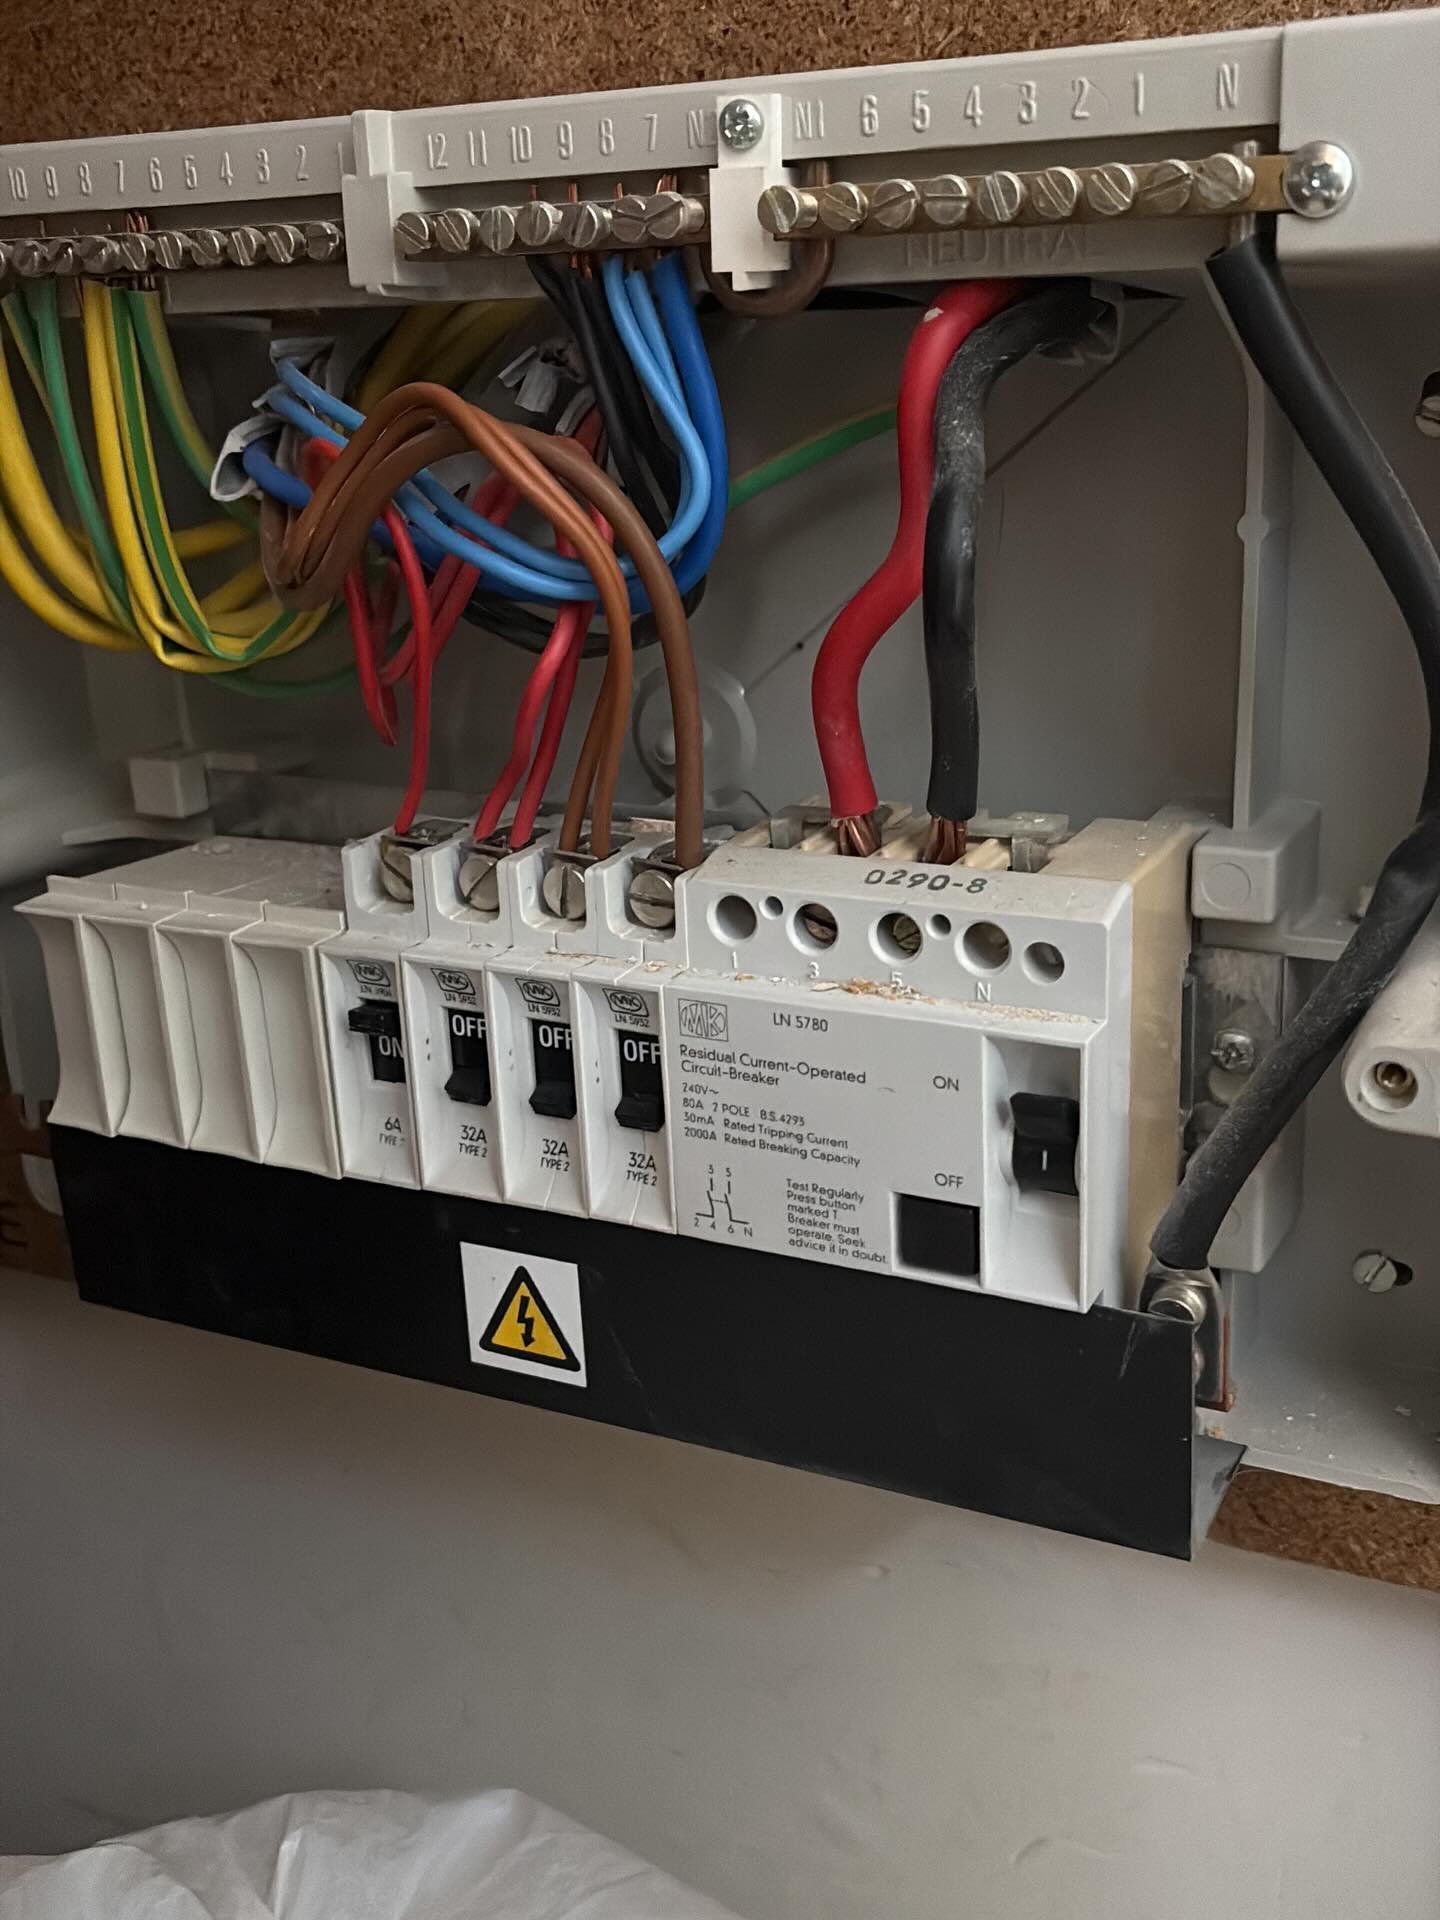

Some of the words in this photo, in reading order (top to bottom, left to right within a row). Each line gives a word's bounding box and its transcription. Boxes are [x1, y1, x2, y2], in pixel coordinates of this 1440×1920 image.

[860, 94, 878, 136] 6
[912, 89, 931, 132] 5
[964, 85, 983, 127] 4
[1018, 80, 1037, 124] 3
[1071, 76, 1090, 120] 2
[1134, 72, 1145, 116] 1
[1216, 63, 1240, 110] N
[427, 132, 448, 170] 12
[468, 128, 488, 166] 11
[509, 124, 533, 163] 10
[558, 120, 574, 160] 9
[599, 117, 615, 156] 8
[643, 113, 657, 152] 7
[7, 166, 29, 201] 10
[44, 165, 59, 198] 9
[78, 161, 92, 196] 8
[113, 160, 124, 193] 7
[151, 156, 164, 192] 6
[184, 155, 198, 190] 5
[219, 151, 233, 187] 4
[256, 148, 270, 184] 3
[296, 145, 310, 182] 2
[864, 868, 989, 894] 0290-8
[731, 951, 739, 969] 1
[808, 962, 820, 980] 3
[890, 971, 903, 989] 5
[976, 982, 992, 1002] N
[452, 1014, 487, 1039] OFF
[773, 1012, 791, 1027] LN
[796, 1015, 829, 1032] 5780
[379, 1035, 404, 1058] ON
[539, 1025, 573, 1050] OFF
[623, 1039, 661, 1065] OFF
[680, 1044, 736, 1064] Residual
[740, 1053, 866, 1084] Current-Operated
[681, 1060, 779, 1086] Circuit-Breaker
[932, 1075, 960, 1092] ON
[683, 1097, 704, 1110] 80A
[722, 1104, 750, 1117] POLE
[385, 1117, 402, 1133] 6A
[460, 1125, 488, 1144] 32A
[683, 1111, 715, 1125] 30mA
[723, 1118, 755, 1133] Rated
[758, 1124, 804, 1144] Tripping
[806, 1132, 849, 1149] Current
[459, 1143, 480, 1157] TYPE
[481, 1148, 488, 1158] 2
[542, 1138, 569, 1158] 32A
[684, 1127, 717, 1141] 2000A
[724, 1133, 756, 1148] Rated
[759, 1139, 808, 1160] Breaking
[811, 1148, 861, 1168] Capacity
[540, 1157, 562, 1171] TYPE
[563, 1162, 570, 1172] 2
[628, 1152, 657, 1172] 32A
[725, 1168, 732, 1178] 5
[627, 1170, 649, 1185] TYPE
[651, 1176, 657, 1186] 2
[934, 1173, 964, 1188] OFF
[786, 1178, 809, 1191] Test
[811, 1183, 864, 1205] Regularly
[786, 1190, 816, 1205] Press
[819, 1196, 856, 1212] button
[787, 1204, 829, 1219] marked
[694, 1217, 700, 1228] 2
[710, 1222, 716, 1230] 4
[728, 1225, 735, 1234] 6
[744, 1227, 753, 1238] N
[787, 1212, 830, 1230] Breaker
[833, 1223, 860, 1236] must
[788, 1238, 826, 1252] advice
[838, 1245, 849, 1256] in
